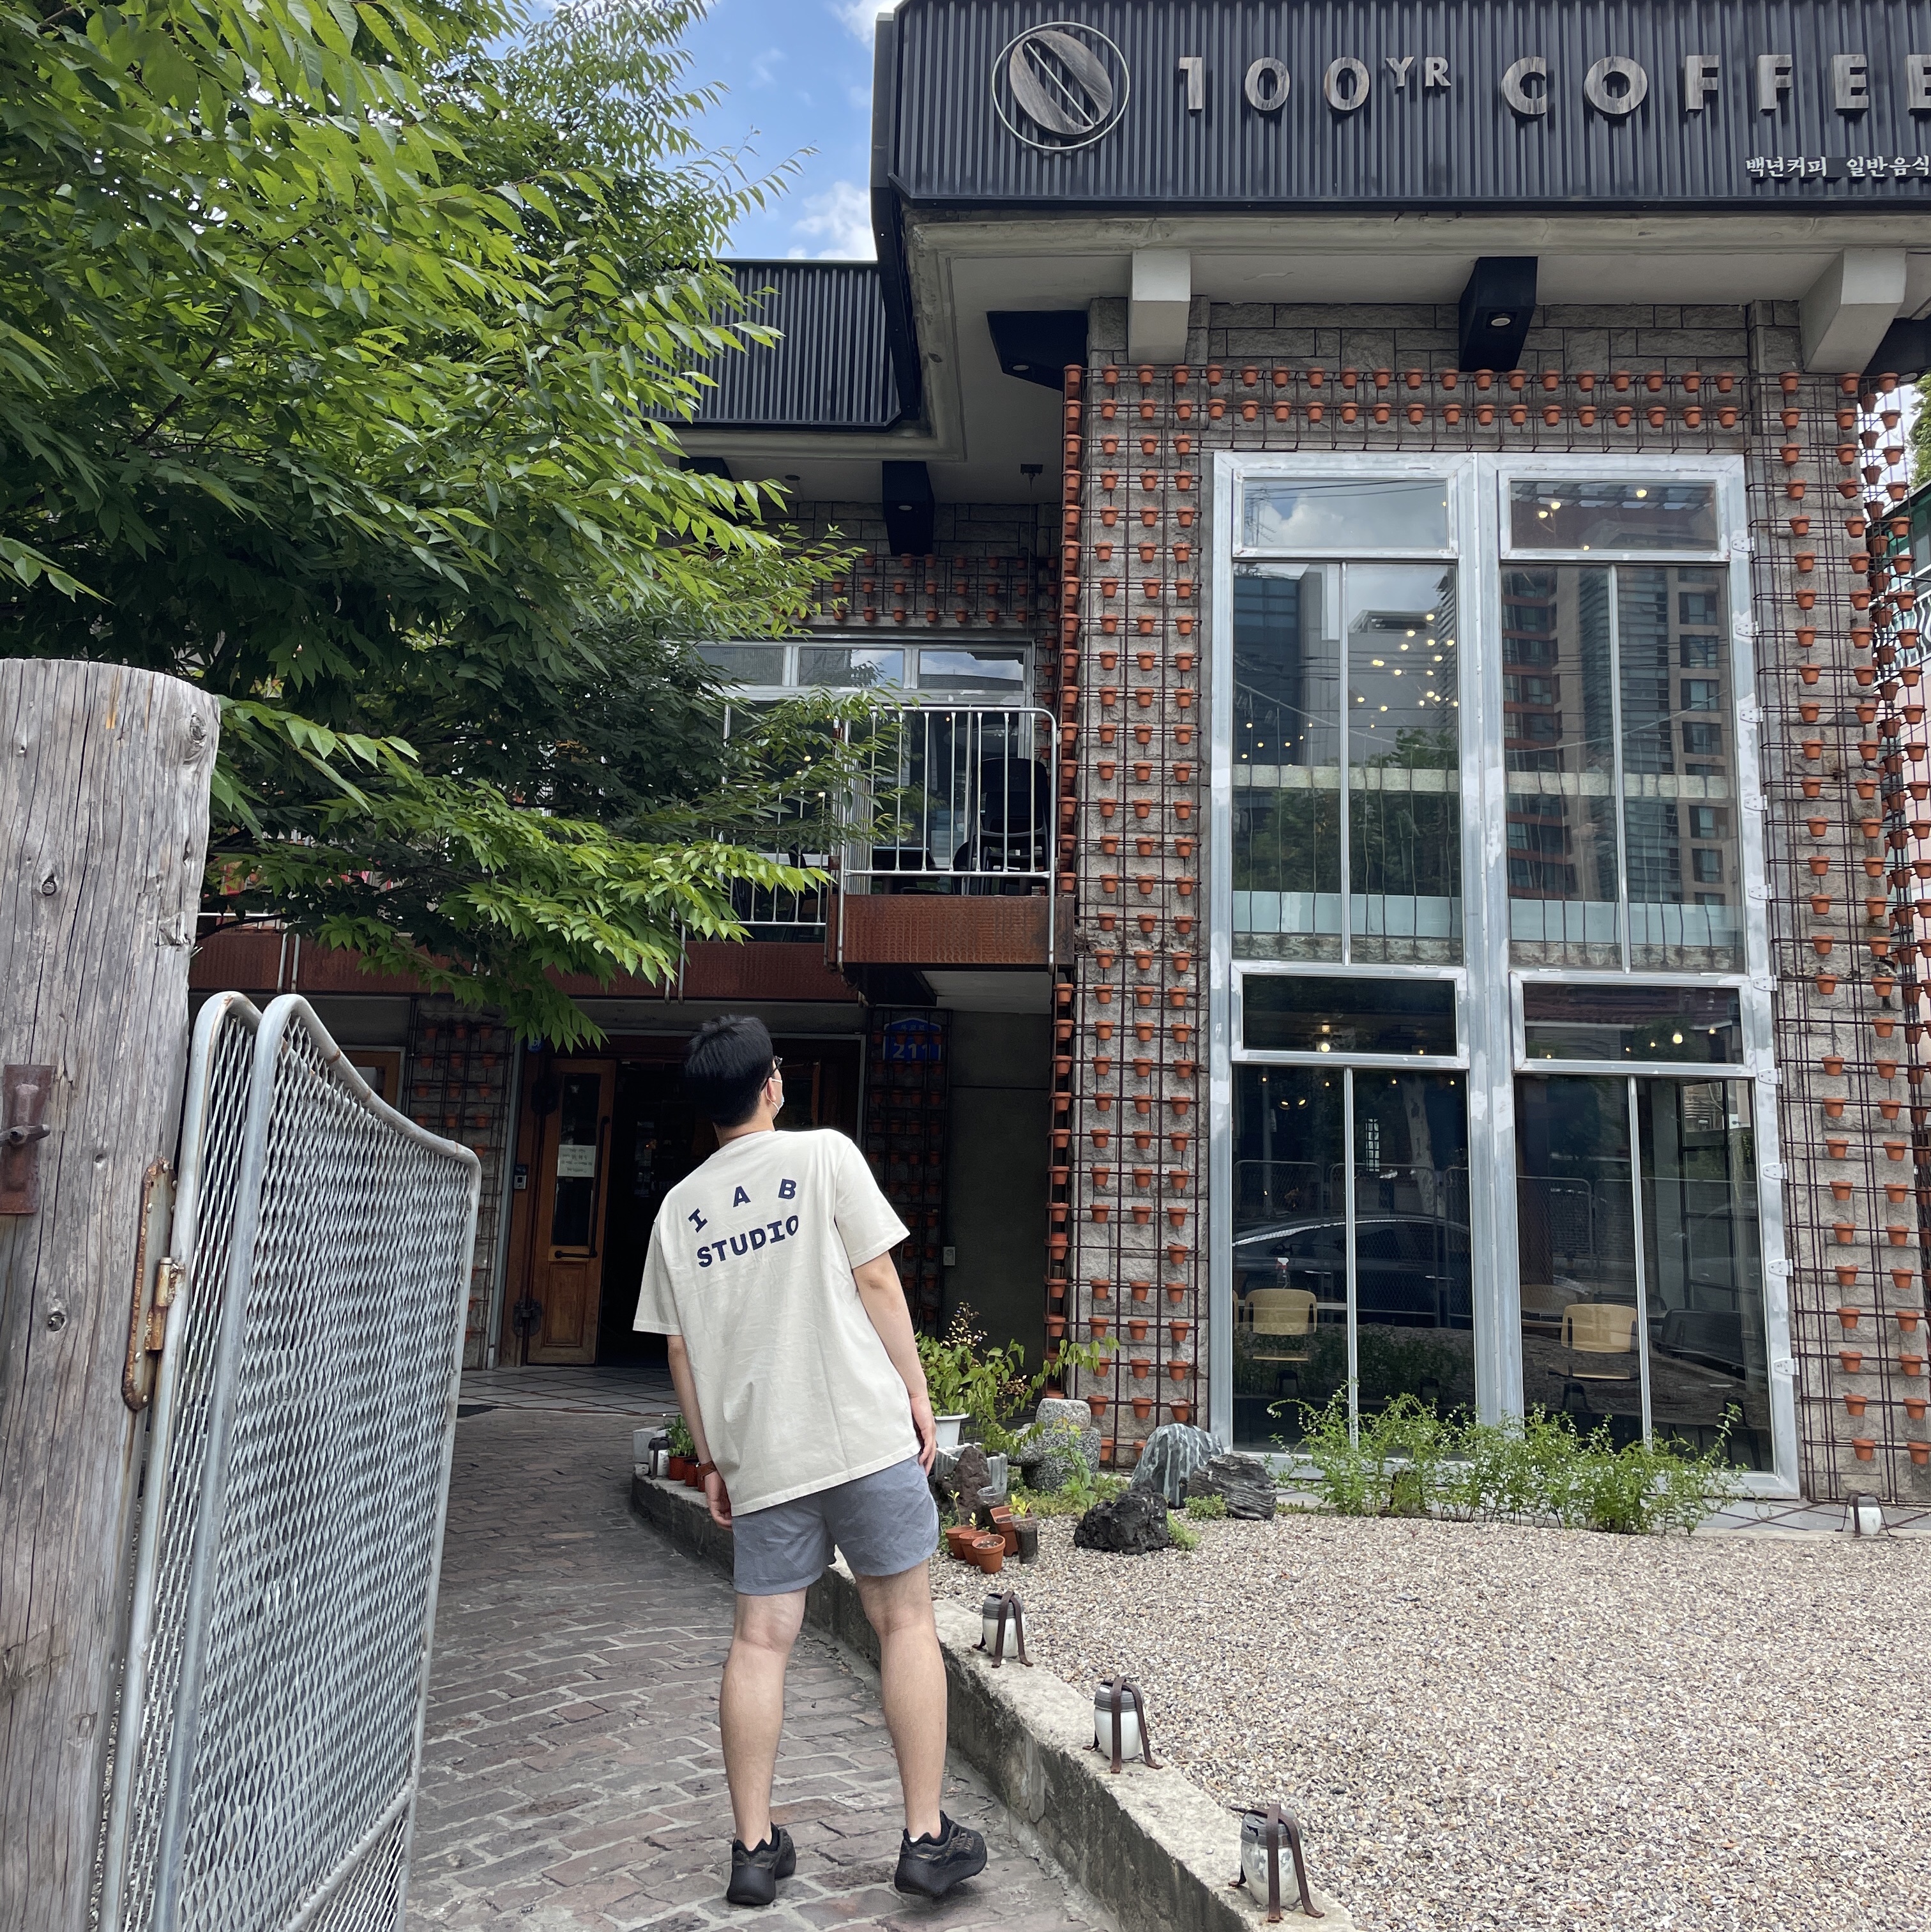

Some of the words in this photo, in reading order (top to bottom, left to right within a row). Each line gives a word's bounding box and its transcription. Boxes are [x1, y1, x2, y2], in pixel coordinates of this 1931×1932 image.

[1501, 54, 1931, 116] COFFEE
[1745, 156, 1827, 178] 백년커피
[697, 1215, 799, 1268] STUDIO
